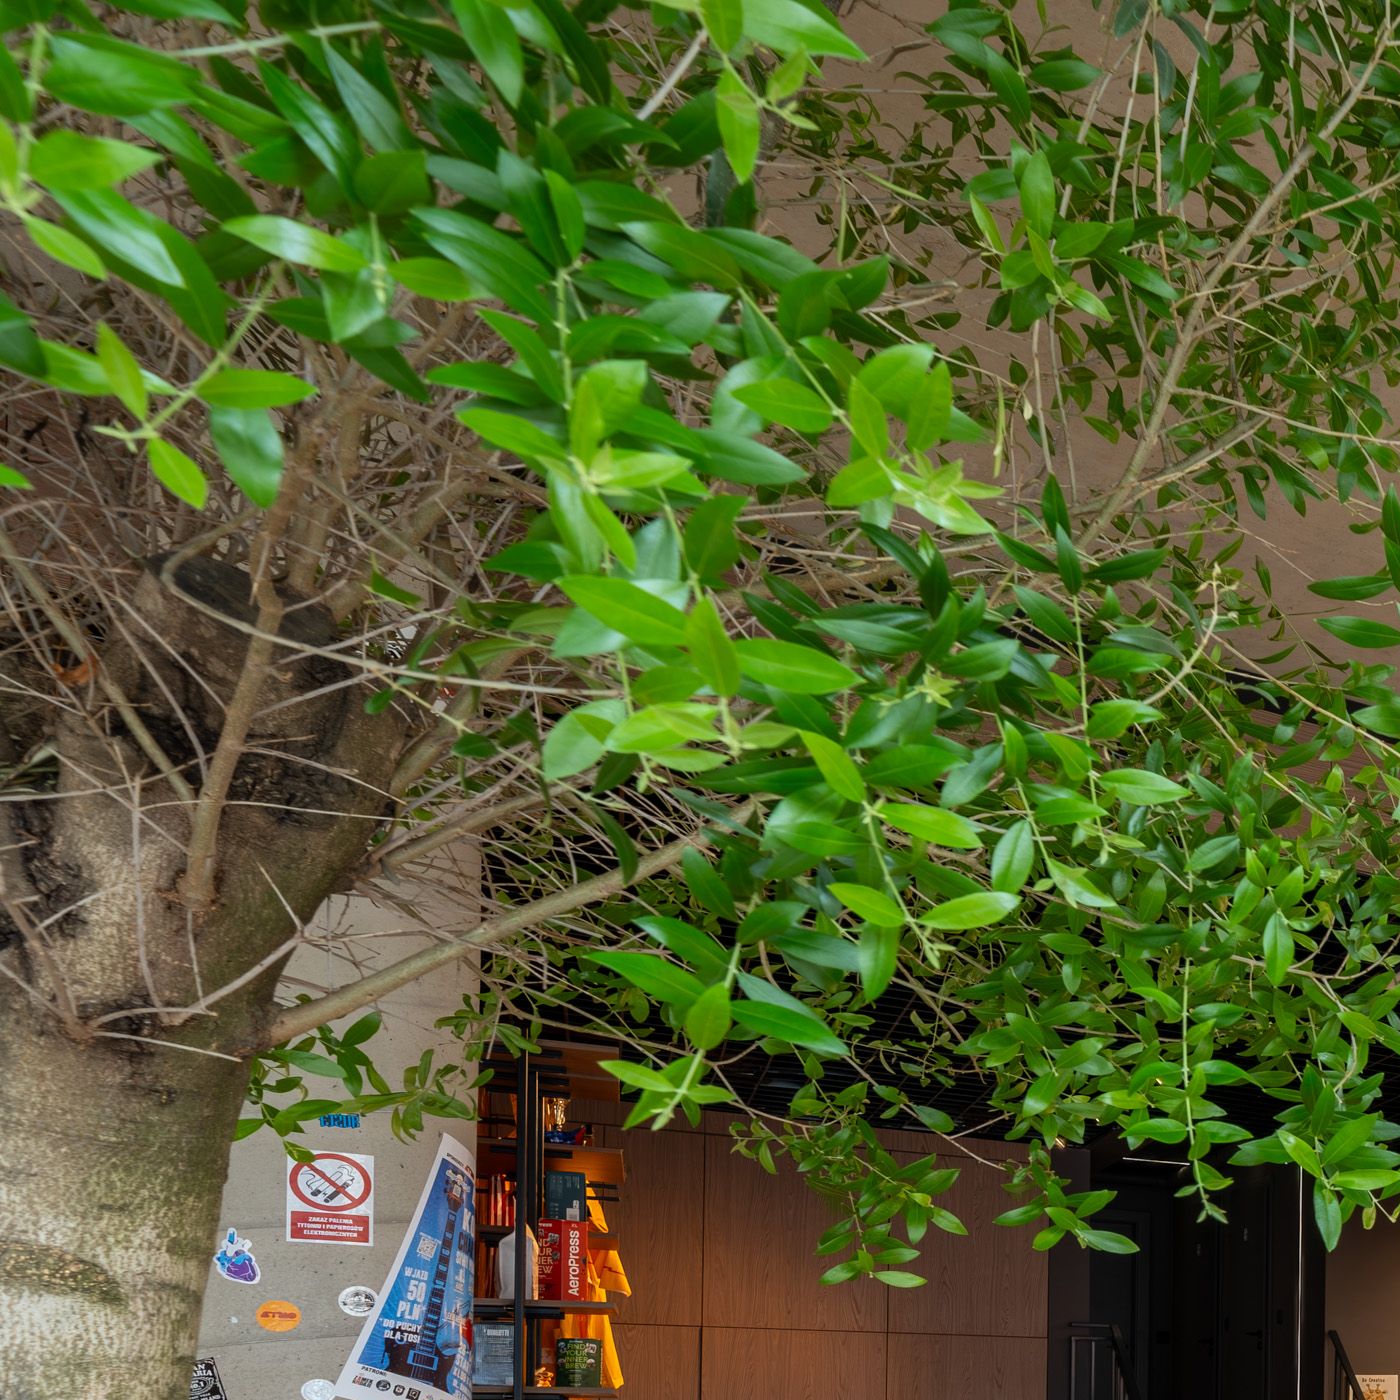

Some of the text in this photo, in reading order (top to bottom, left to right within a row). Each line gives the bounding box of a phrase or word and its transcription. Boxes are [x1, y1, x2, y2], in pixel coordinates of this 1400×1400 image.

[303, 1229, 358, 1238] ELEKTRONICZNYCH
[568, 1230, 580, 1296] AeroPress
[407, 1279, 427, 1303] 50
[396, 1300, 421, 1320] PLN
[384, 1330, 401, 1340] DLA
[396, 1321, 422, 1333] PUCHY
